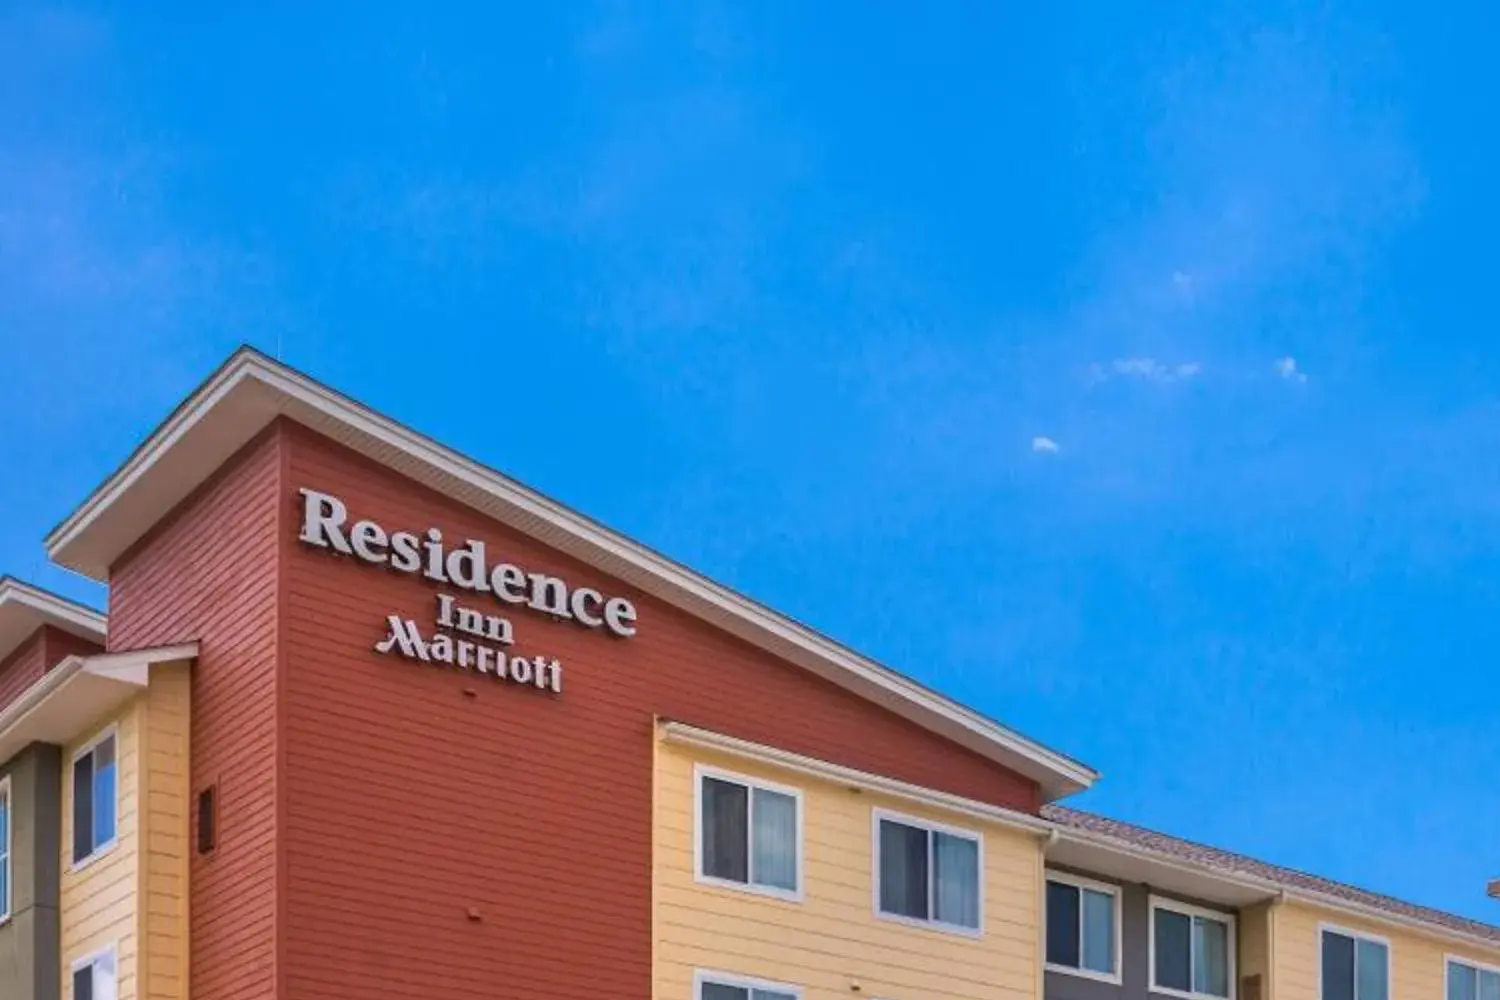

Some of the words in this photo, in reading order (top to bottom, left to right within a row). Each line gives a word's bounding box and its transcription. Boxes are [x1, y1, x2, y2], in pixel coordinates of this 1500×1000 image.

[299, 487, 638, 636] Residence
[375, 614, 563, 693] Marriott
[435, 593, 514, 645] Inn
